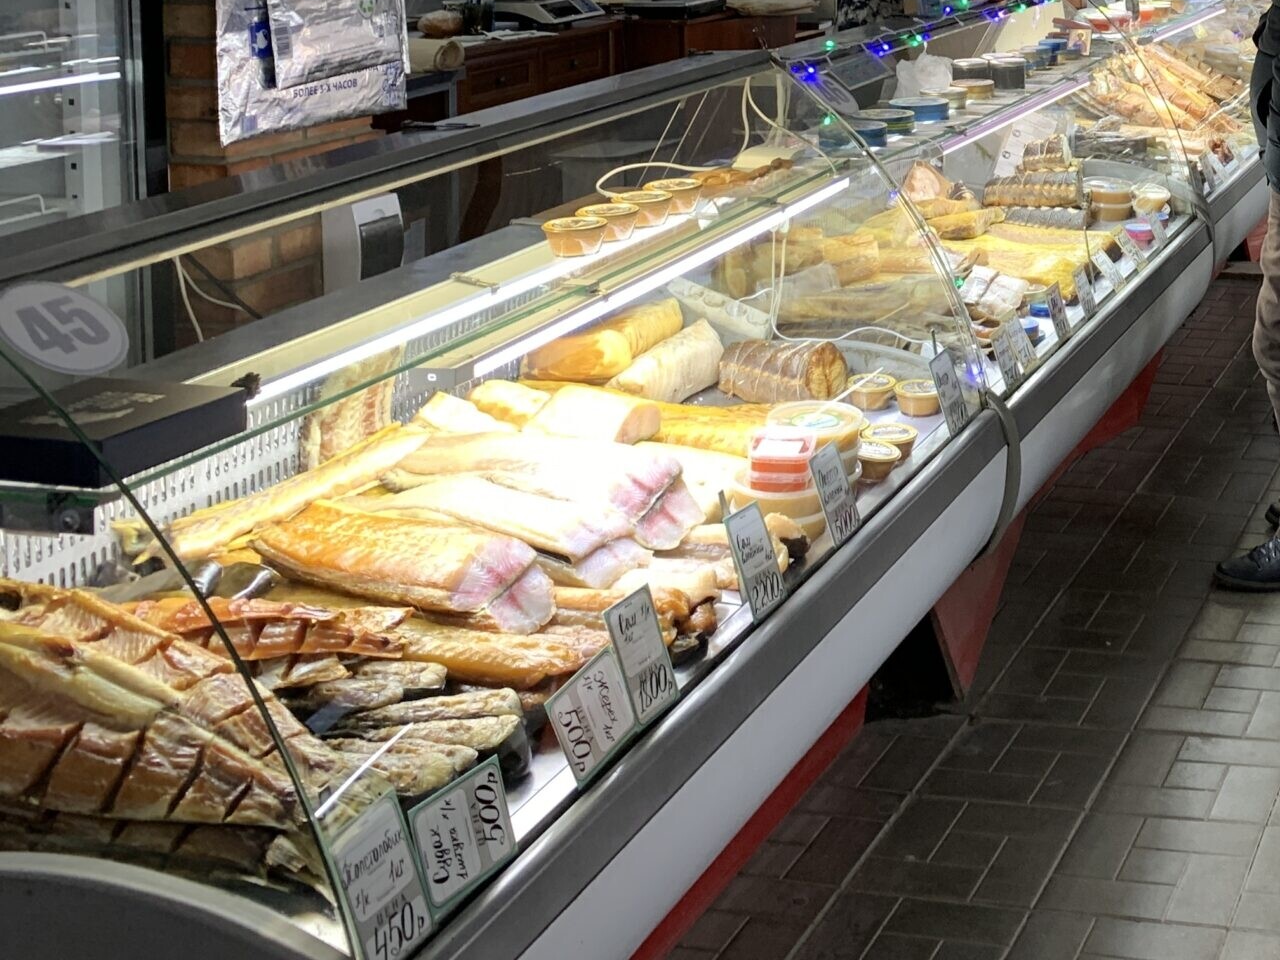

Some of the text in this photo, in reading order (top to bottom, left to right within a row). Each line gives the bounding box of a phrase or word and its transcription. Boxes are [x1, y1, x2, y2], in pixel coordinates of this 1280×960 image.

[293, 87, 318, 99] БОЛЕЕ
[333, 78, 358, 91] ЧАСОВ
[16, 295, 111, 354] 45
[474, 771, 506, 846] 500р
[430, 824, 452, 885] Судак
[374, 901, 425, 960] 450р
